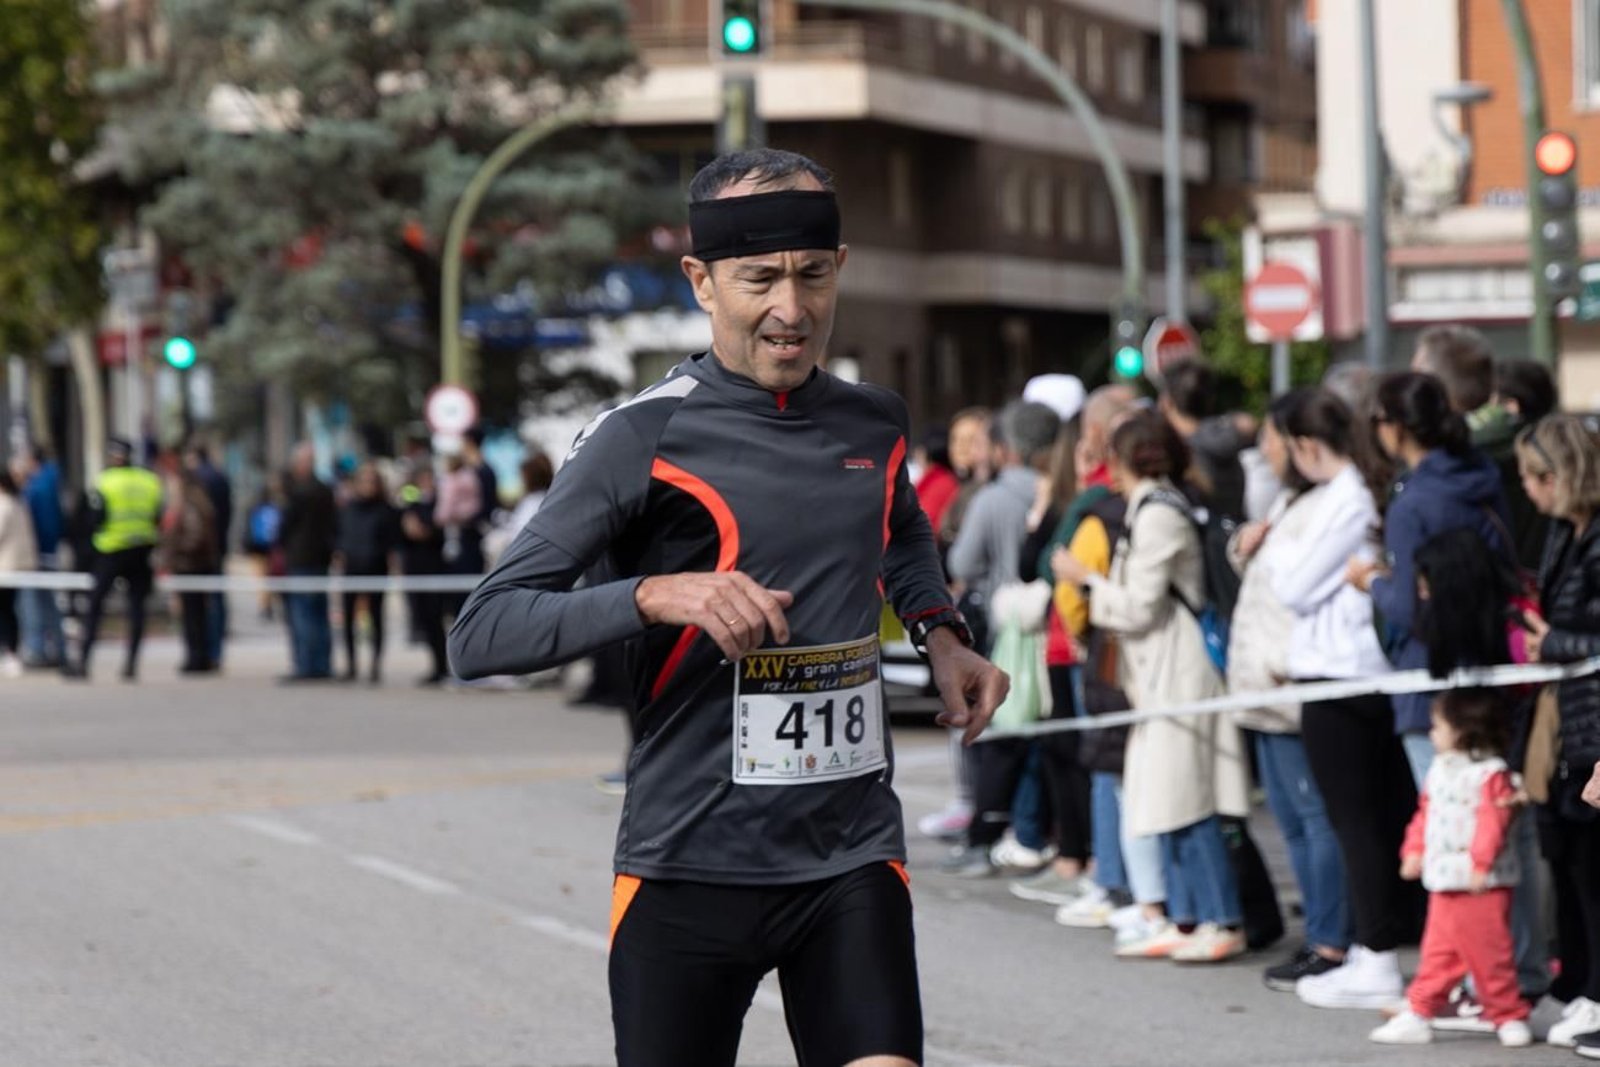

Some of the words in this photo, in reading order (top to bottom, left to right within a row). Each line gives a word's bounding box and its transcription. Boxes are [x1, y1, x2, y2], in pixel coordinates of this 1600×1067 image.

[745, 656, 785, 678] XXV
[787, 651, 844, 666] CARRERA
[804, 664, 837, 678] gran
[775, 694, 865, 750] 418
